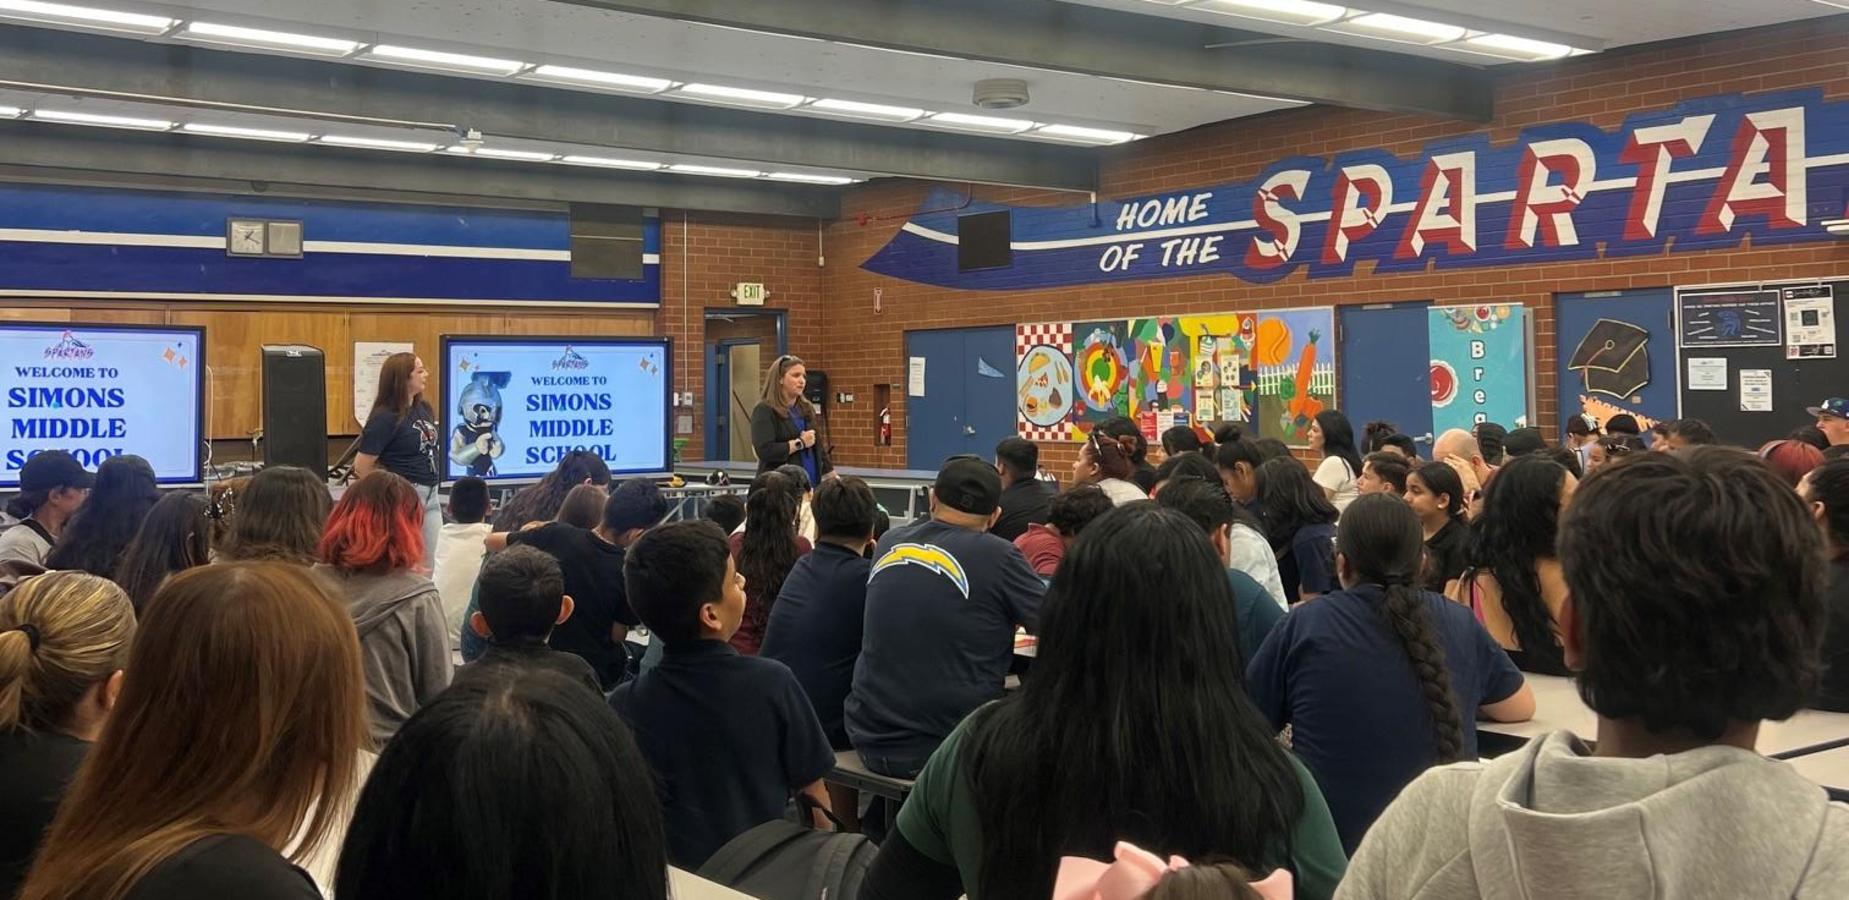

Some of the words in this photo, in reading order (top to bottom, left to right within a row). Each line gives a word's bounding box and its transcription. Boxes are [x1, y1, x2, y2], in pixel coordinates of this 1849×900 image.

[1244, 106, 1849, 270] SPARTA
[1116, 192, 1213, 231] HOME
[1099, 243, 1144, 272] OF
[1160, 235, 1224, 267] THE
[744, 284, 760, 299] EXIT
[15, 366, 95, 378] WELCOME
[98, 367, 118, 378] TO
[531, 376, 590, 386] WELCOME
[591, 376, 607, 386] TO
[8, 387, 125, 408] SIMONS
[526, 393, 612, 411] SIMONS
[11, 417, 127, 439] MIDDLE
[529, 419, 614, 438] MIDDLE
